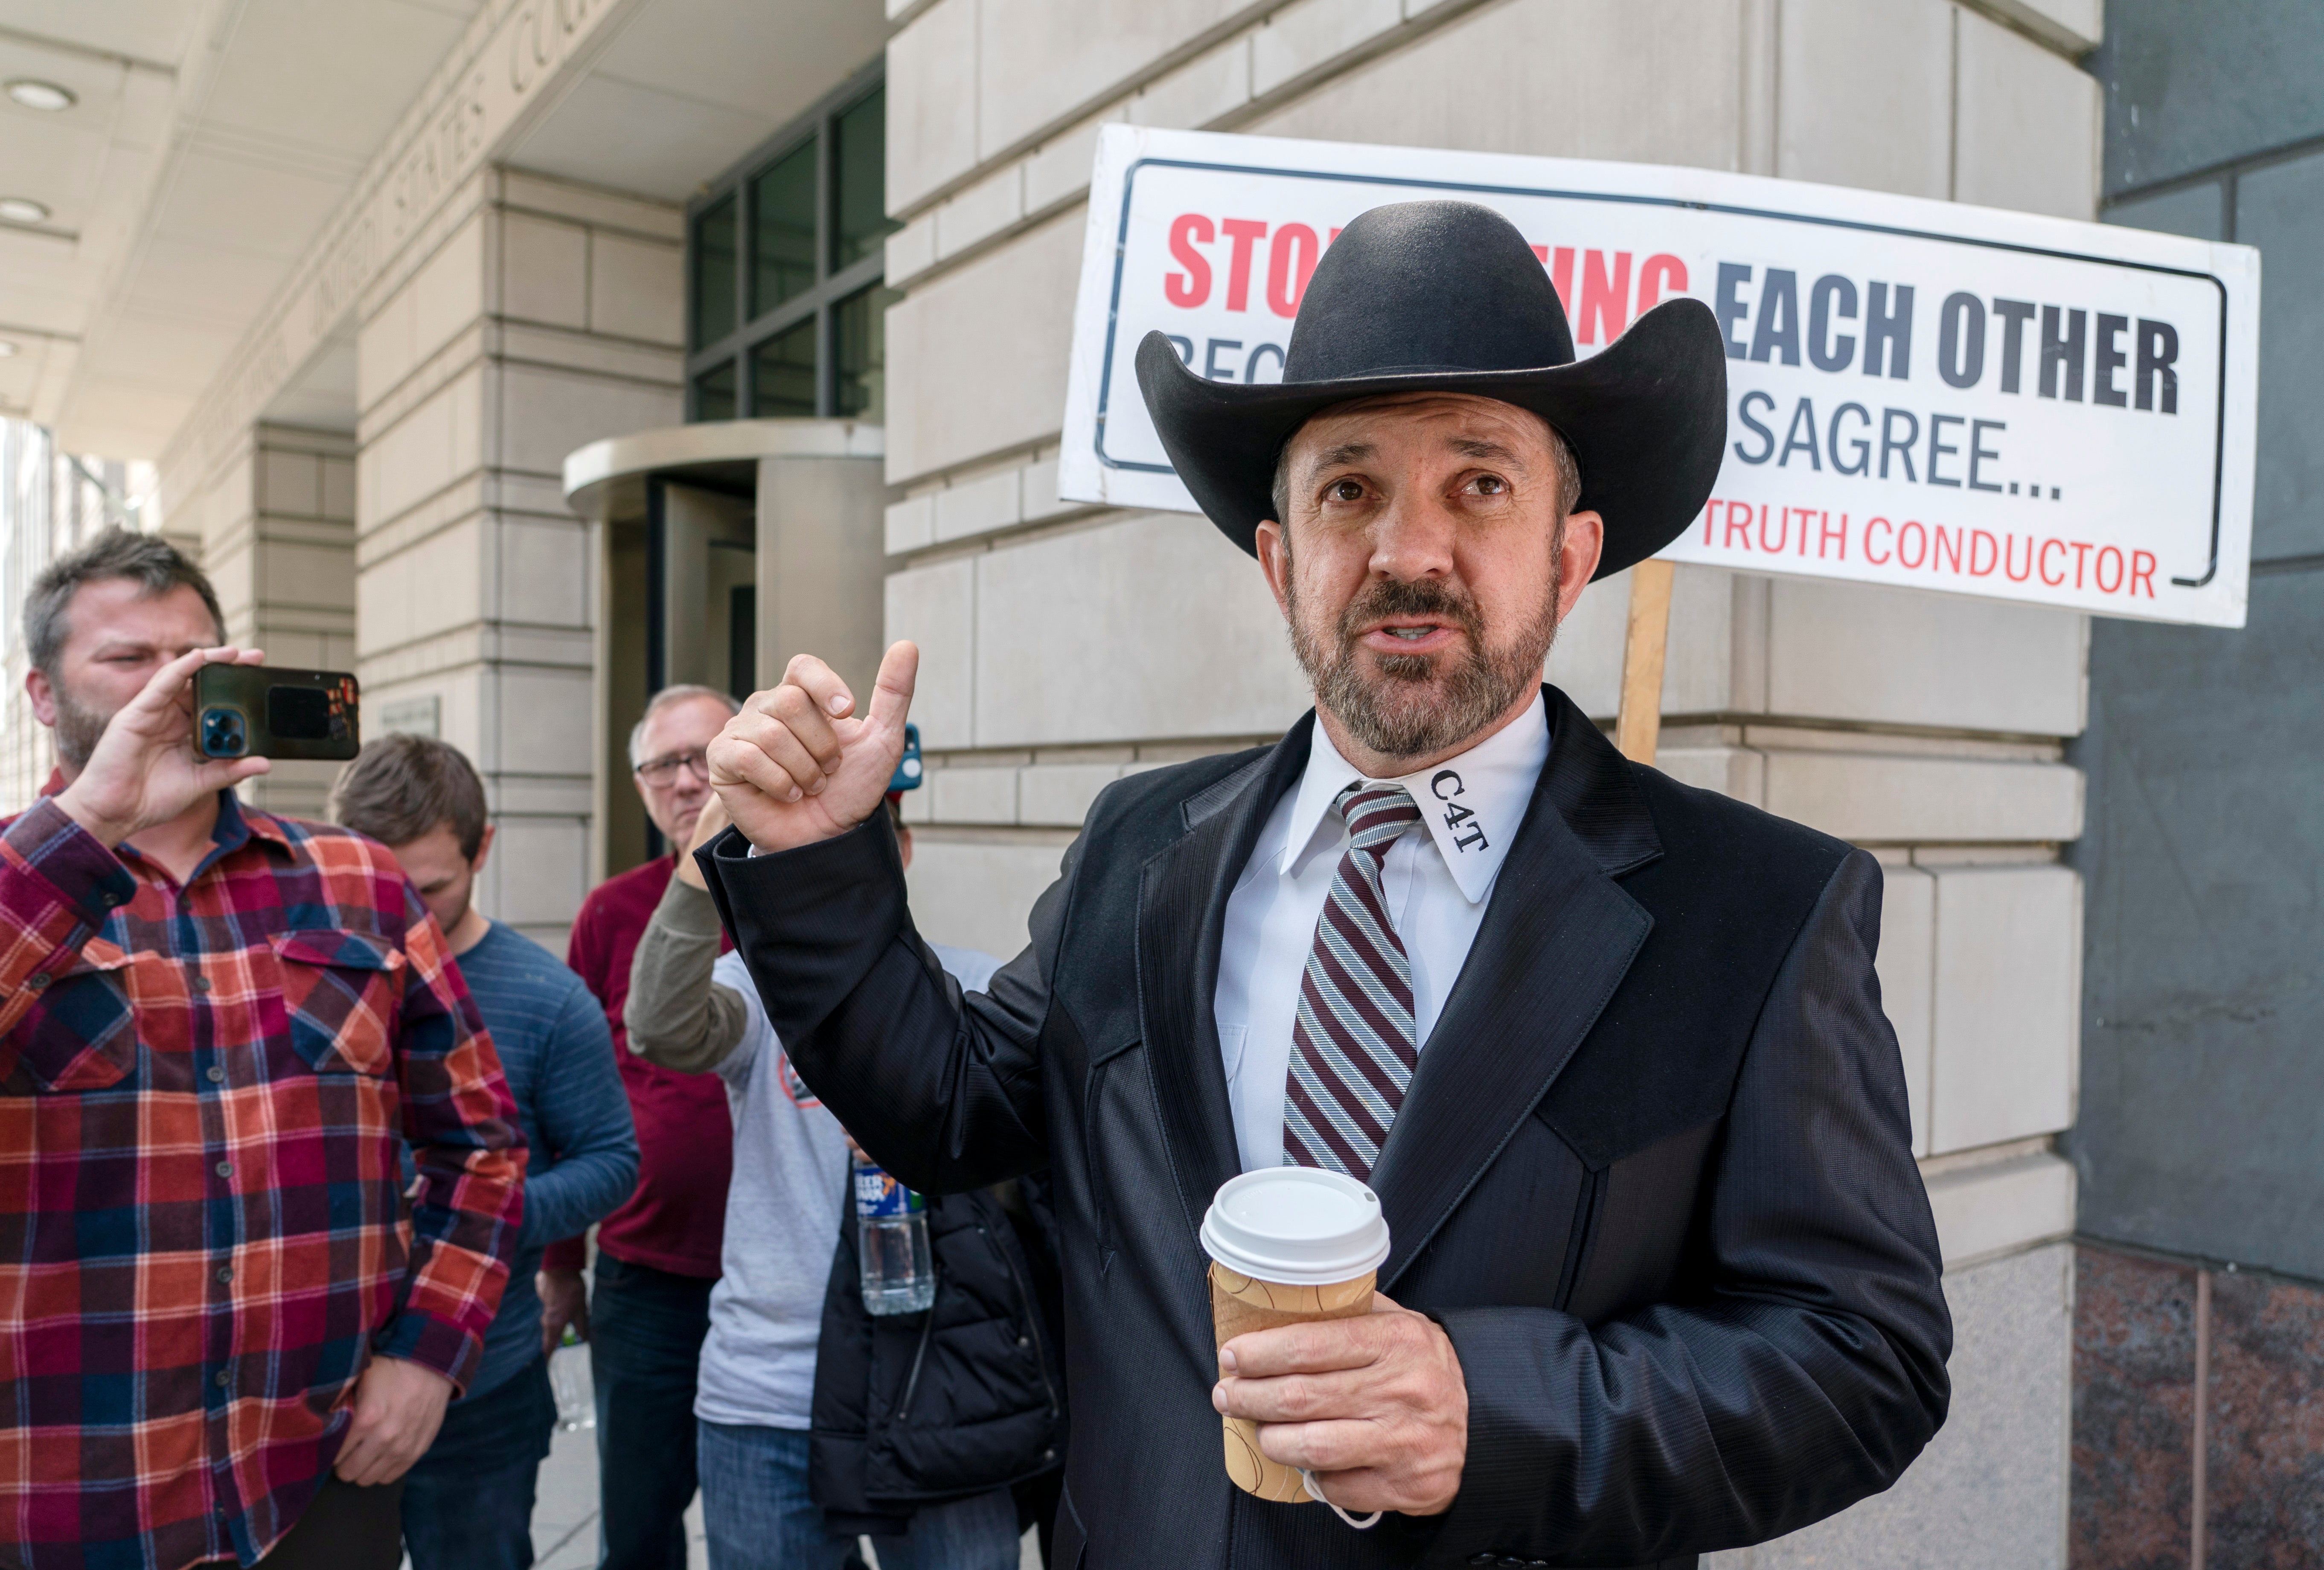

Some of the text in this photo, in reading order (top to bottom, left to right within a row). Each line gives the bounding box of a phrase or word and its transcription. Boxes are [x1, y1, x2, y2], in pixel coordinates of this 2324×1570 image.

[393, 71, 487, 237] STATES
[1165, 212, 1343, 319] STO
[1715, 262, 1914, 381] EACH
[1938, 291, 2179, 416] OTHER
[1727, 390, 2061, 500] SAGREE...
[1704, 499, 2157, 599] TRUTH CONDUCTOR
[1431, 770, 1489, 853] C4T
